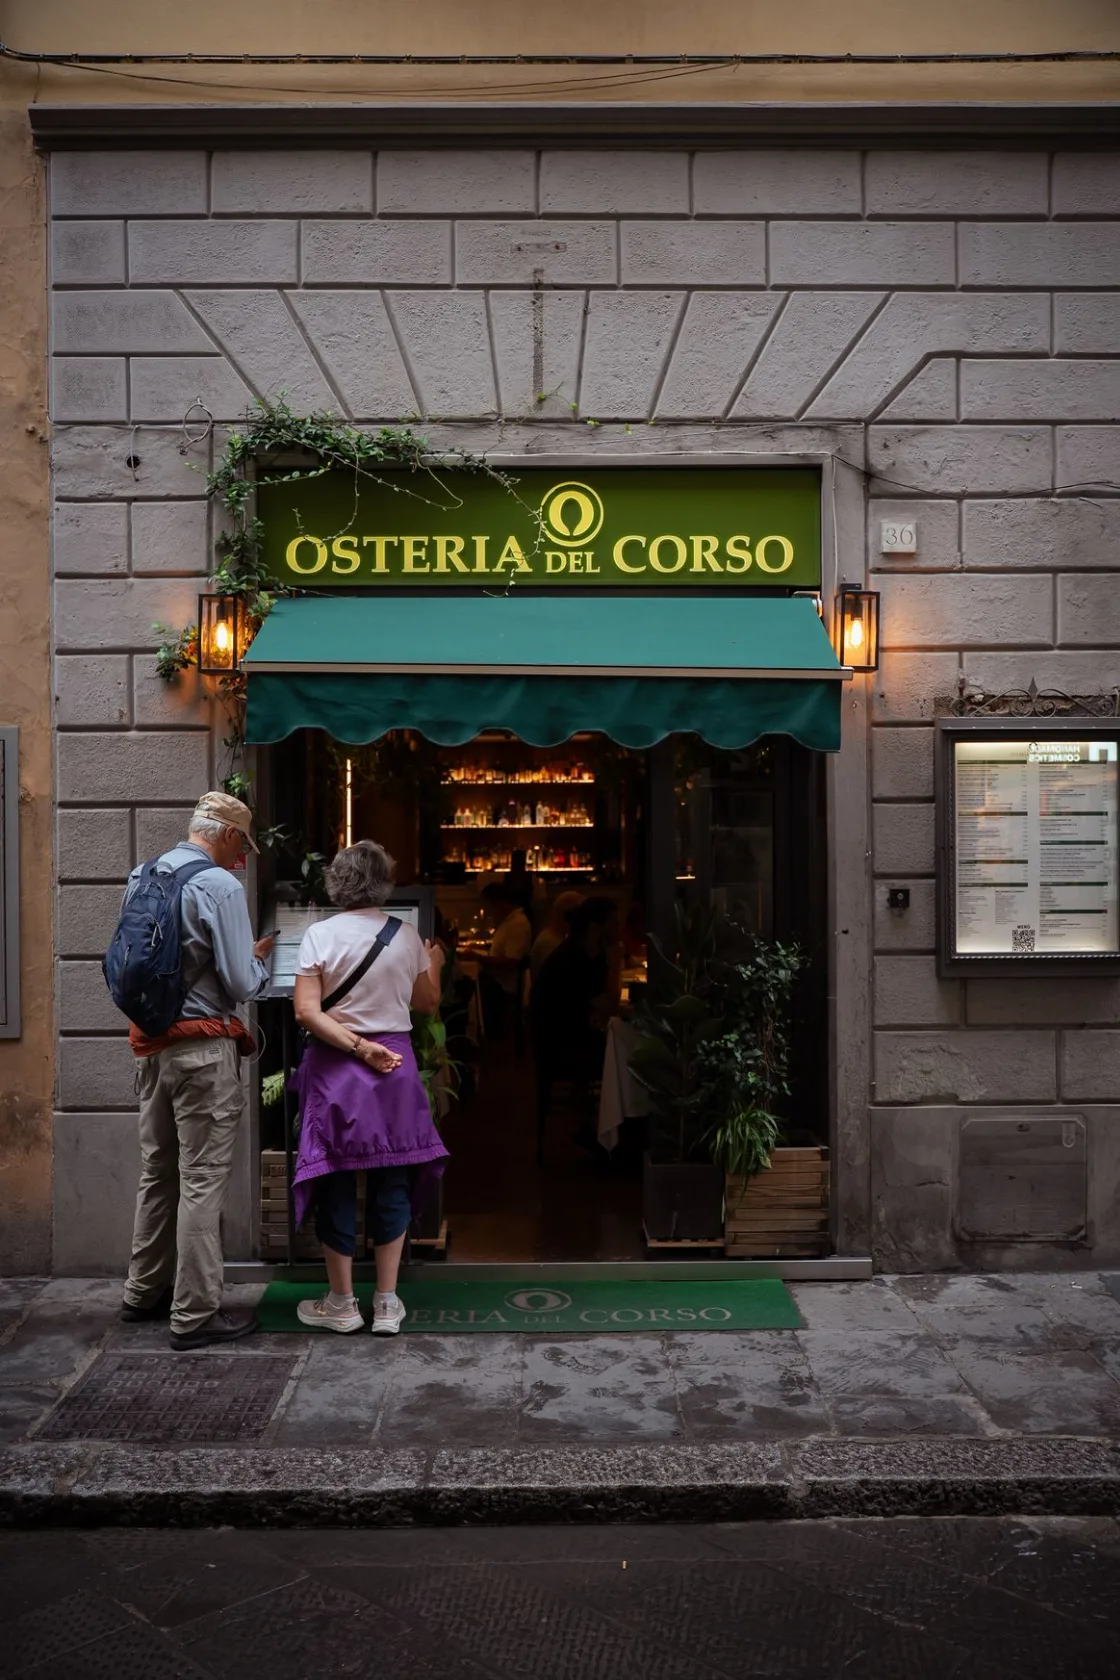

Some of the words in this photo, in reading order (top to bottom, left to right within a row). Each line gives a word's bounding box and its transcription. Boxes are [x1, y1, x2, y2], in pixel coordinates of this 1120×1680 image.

[885, 525, 913, 546] 36
[285, 535, 533, 574] OSTERIA
[545, 551, 600, 573] DEL
[613, 534, 794, 573] CORSO
[408, 1308, 509, 1324] ERIA
[524, 1315, 566, 1323] DEL
[579, 1307, 732, 1323] CORSO
